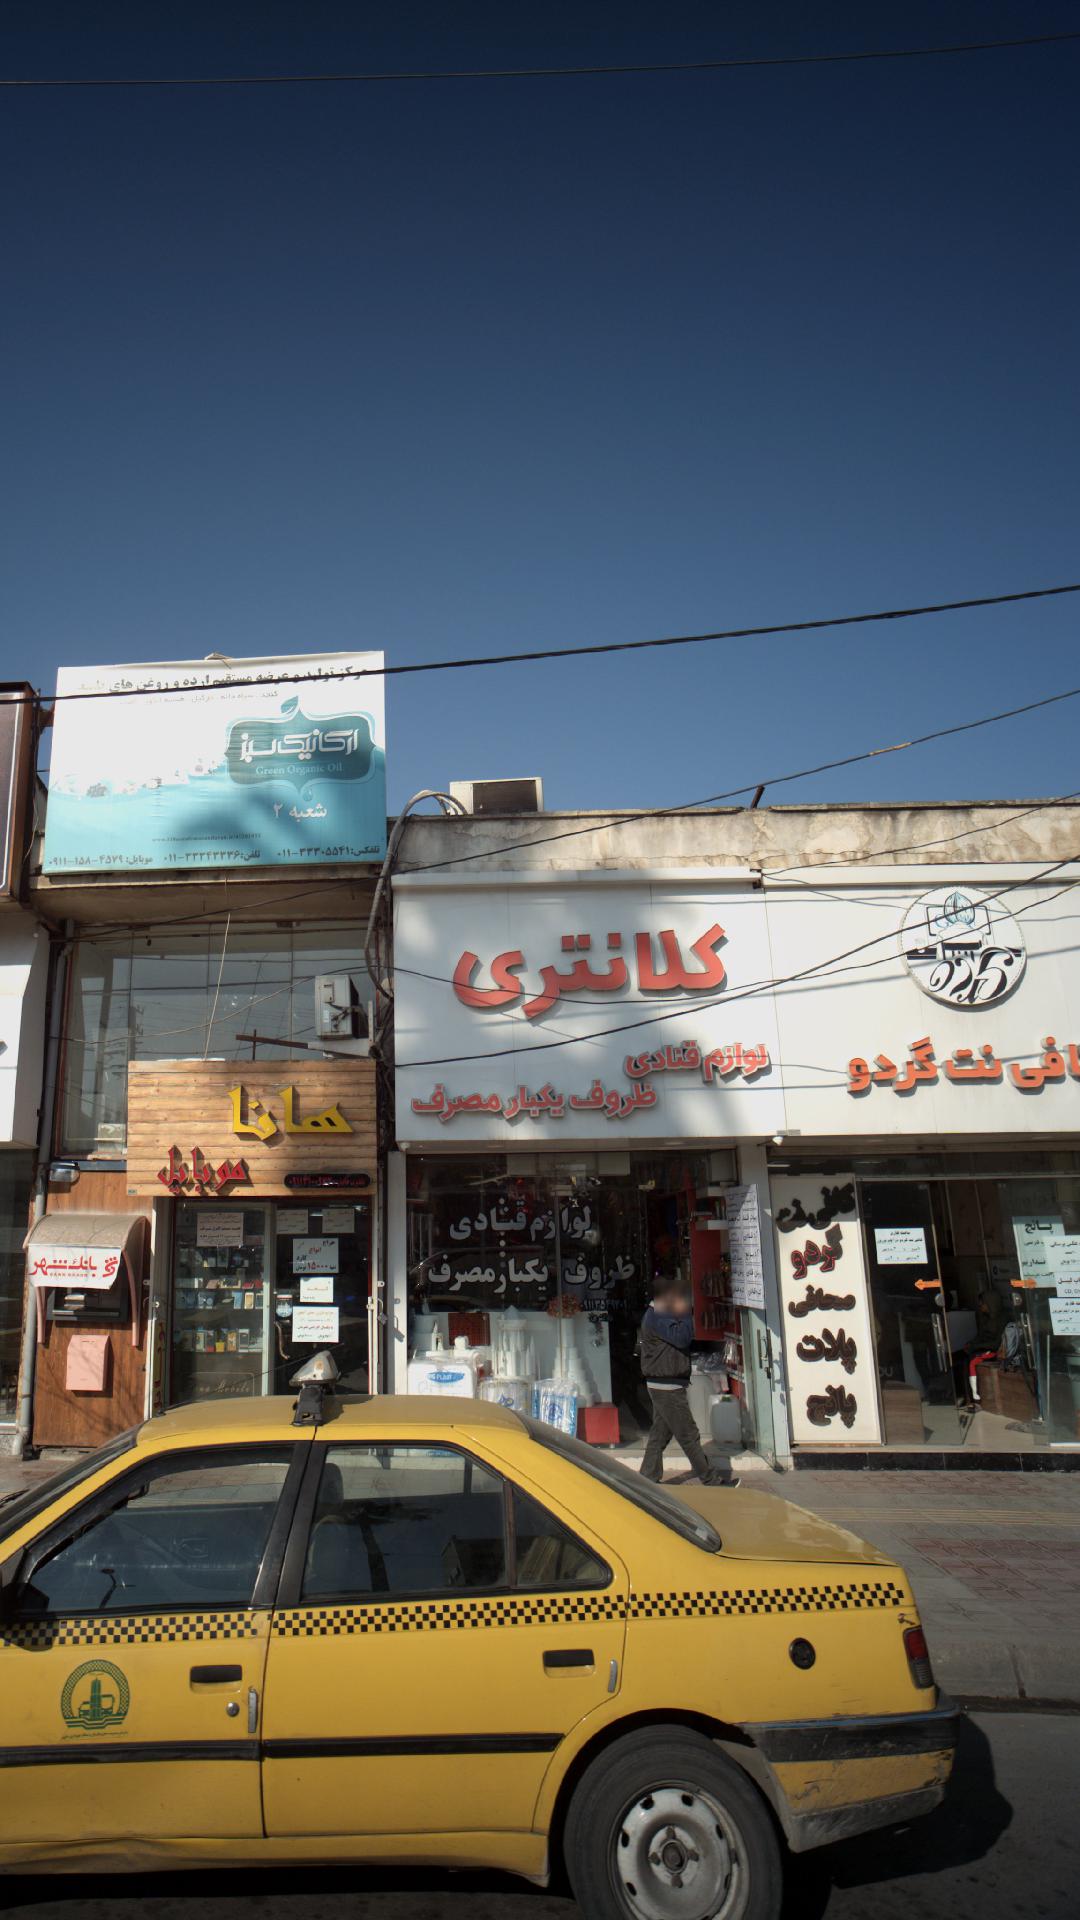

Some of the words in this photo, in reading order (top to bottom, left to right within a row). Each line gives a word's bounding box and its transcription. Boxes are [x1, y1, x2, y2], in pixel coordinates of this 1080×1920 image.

[255, 766, 286, 776] Green
[287, 763, 325, 776] Organic
[328, 762, 343, 771] Oil
[288, 803, 327, 823] شعبه
[453, 923, 727, 1020] کلانتری
[625, 1040, 701, 1079] قنادی
[703, 1043, 770, 1081] لوازم
[847, 1036, 938, 1092] گردو
[945, 1044, 1002, 1079] نت
[1009, 1036, 1080, 1090] افی
[227, 1086, 353, 1141] هانا
[569, 1080, 656, 1118] ظروف
[157, 1145, 247, 1194] موبایل
[449, 1200, 526, 1240] قنادی
[529, 1204, 592, 1241] لوازم
[790, 1223, 844, 1281] گردو
[563, 1254, 636, 1290] ظروف
